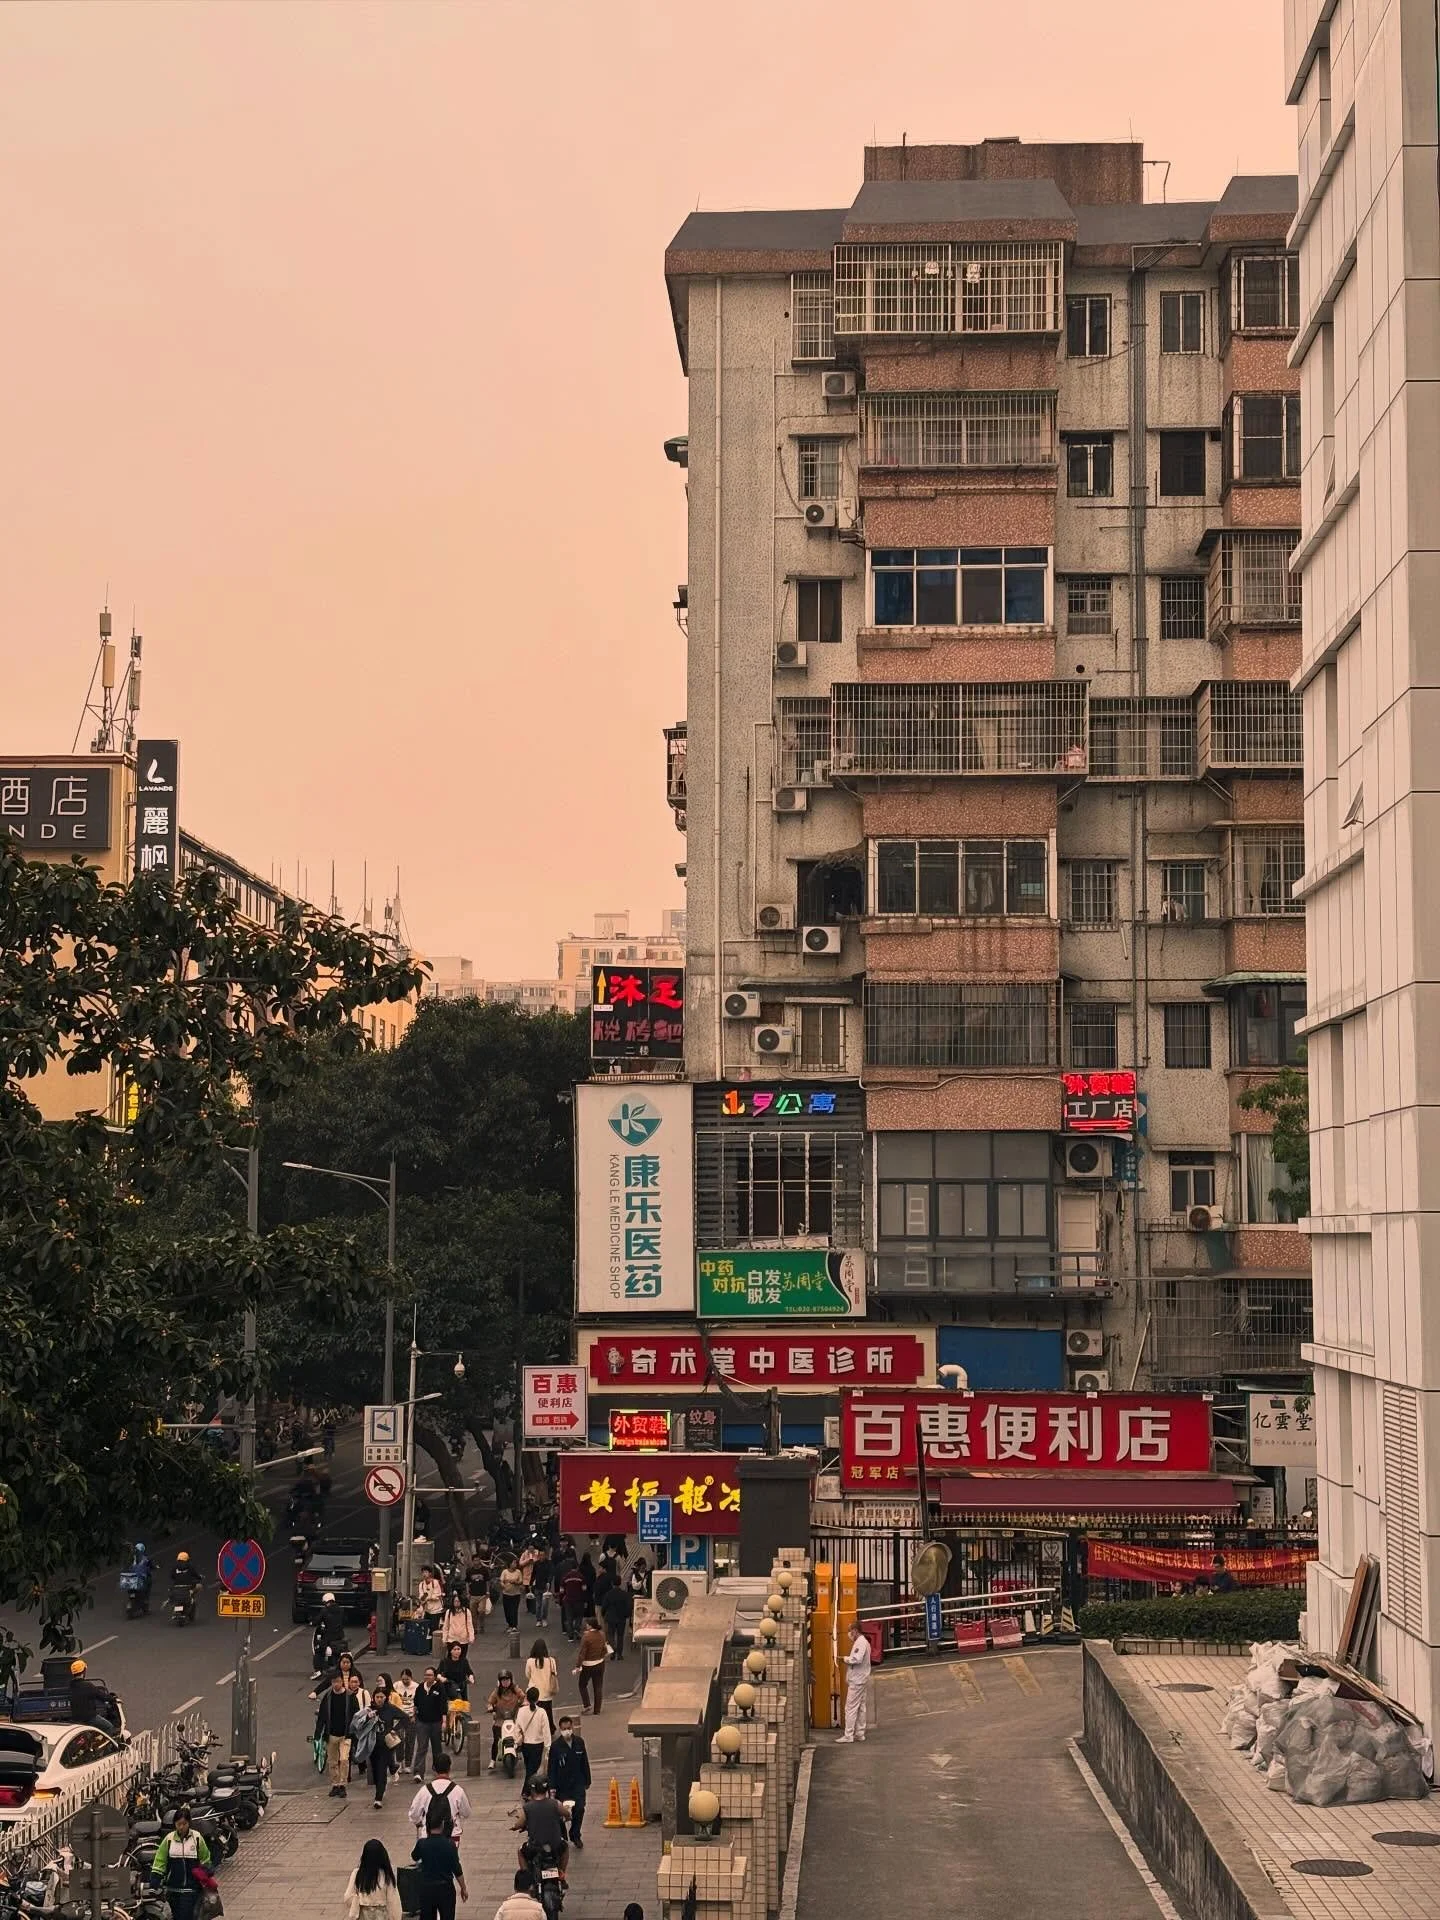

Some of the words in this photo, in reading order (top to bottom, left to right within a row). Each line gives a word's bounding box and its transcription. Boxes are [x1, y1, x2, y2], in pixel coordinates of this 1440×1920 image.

[1067, 1075, 1135, 1096] 外贸鞋
[1068, 1099, 1133, 1118] 工厂店
[610, 1154, 620, 1186] KANG
[610, 1189, 620, 1202] LE
[610, 1204, 620, 1263] MEDICINE
[624, 1154, 662, 1299] 康乐医药
[701, 1260, 734, 1276] 中药
[610, 1266, 620, 1299] SHOP
[712, 1277, 747, 1294] 对抗
[747, 1270, 782, 1286] 白发
[747, 1288, 782, 1304] 脱发
[631, 1346, 894, 1375] 奇术堂中医诊所
[532, 1374, 578, 1393] 百惠
[537, 1397, 573, 1409] 便利店
[614, 1415, 667, 1434] 外贸鞋
[1253, 1411, 1313, 1431] 亿雲堂
[851, 1403, 1172, 1464] 百惠便利店
[851, 1465, 899, 1480] 冠军店
[645, 1501, 660, 1522] P
[680, 1536, 700, 1564] P
[221, 1598, 264, 1613] 严管路段
